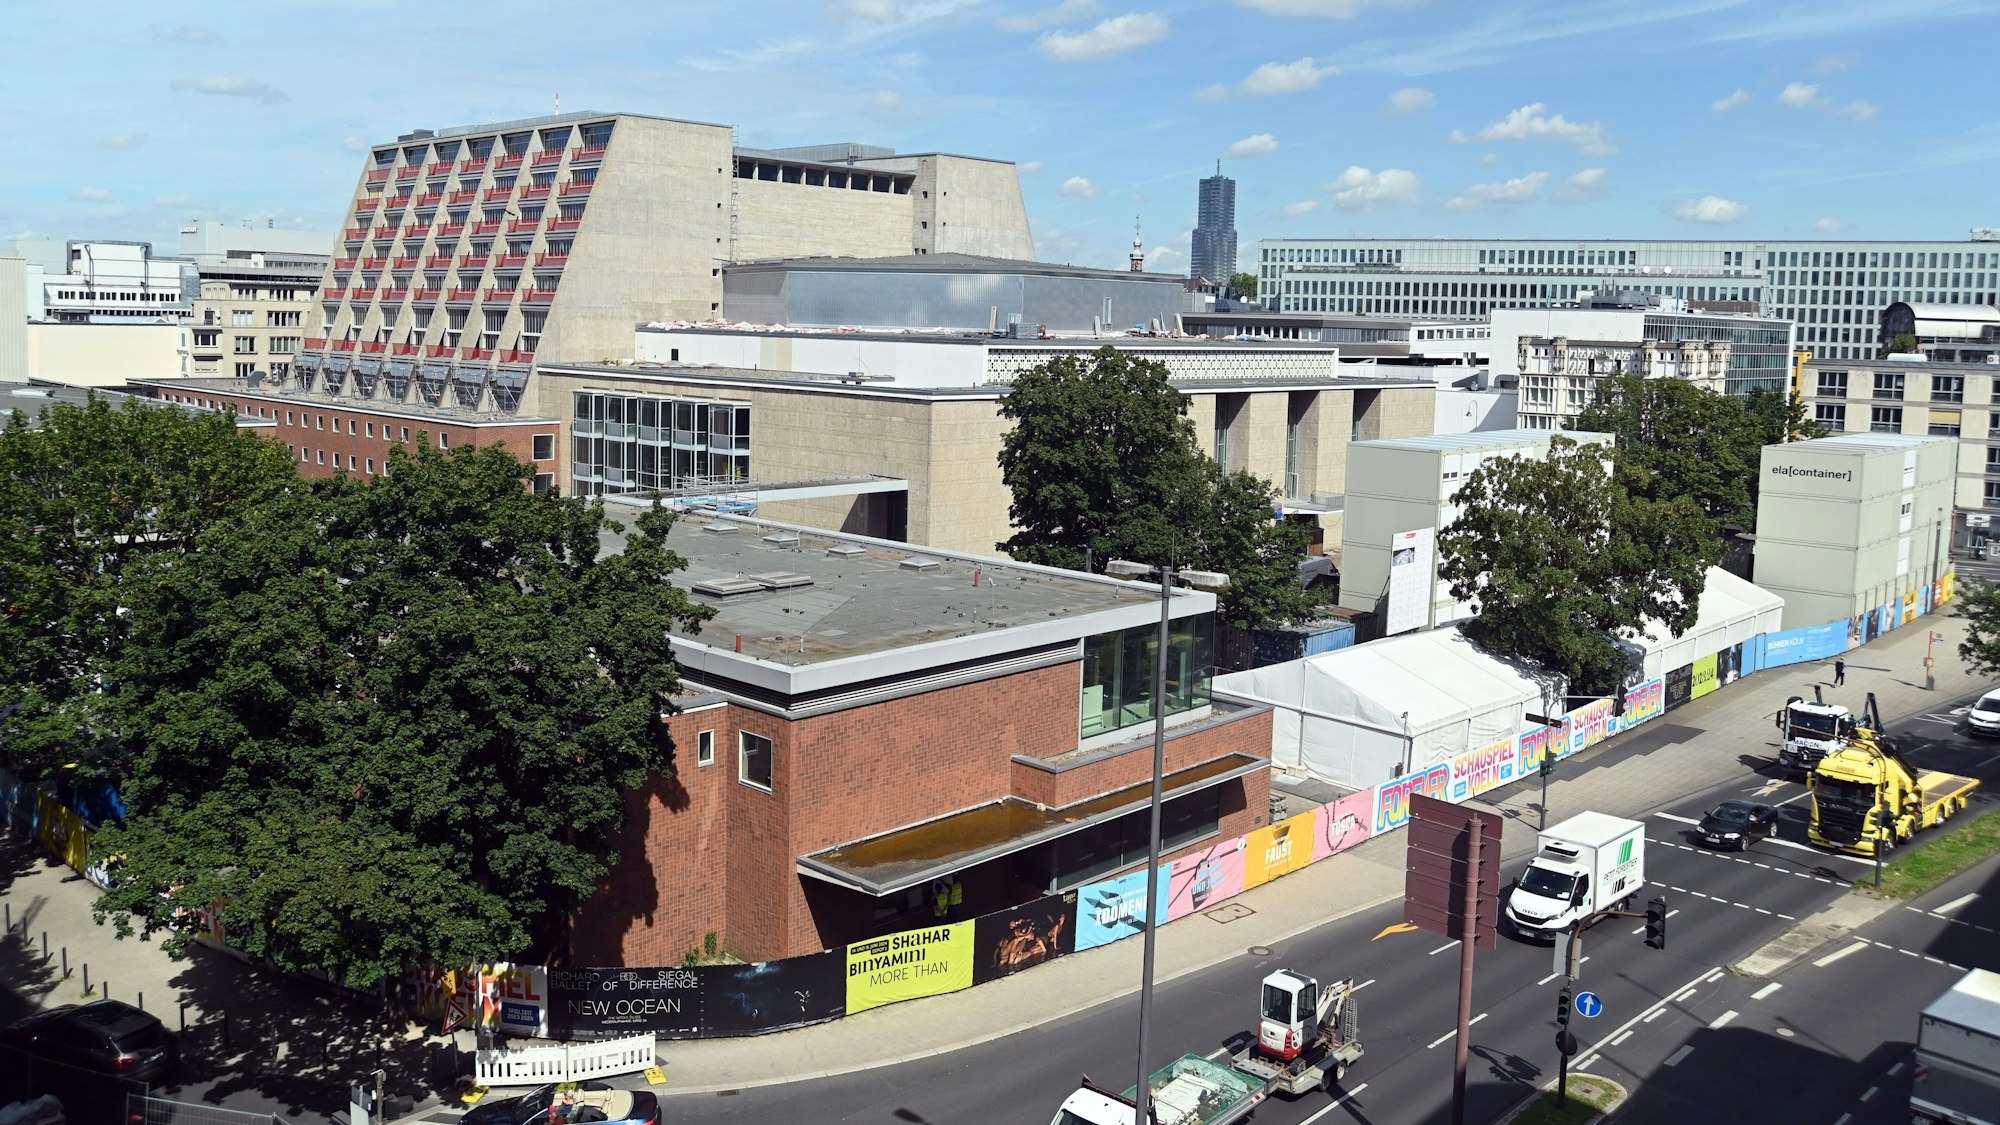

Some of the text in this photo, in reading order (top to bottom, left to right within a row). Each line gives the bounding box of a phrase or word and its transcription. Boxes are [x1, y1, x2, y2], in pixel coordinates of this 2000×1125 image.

[1771, 465, 1852, 482] ela[container]
[1574, 698, 1614, 731] SCHAUSPIE
[1454, 736, 1515, 779] SCHAUSPIEL
[1467, 764, 1500, 796] KOELN
[1331, 813, 1356, 837] TOSCA
[1265, 840, 1293, 865] FAUST
[1522, 908, 1538, 916] IVECO
[550, 970, 698, 982] RICHARD SIEGAL
[551, 979, 698, 991] BALLET OF DIFFERENCE
[870, 960, 948, 987] MORE THAN
[568, 998, 681, 1016] NEW OCEAN
